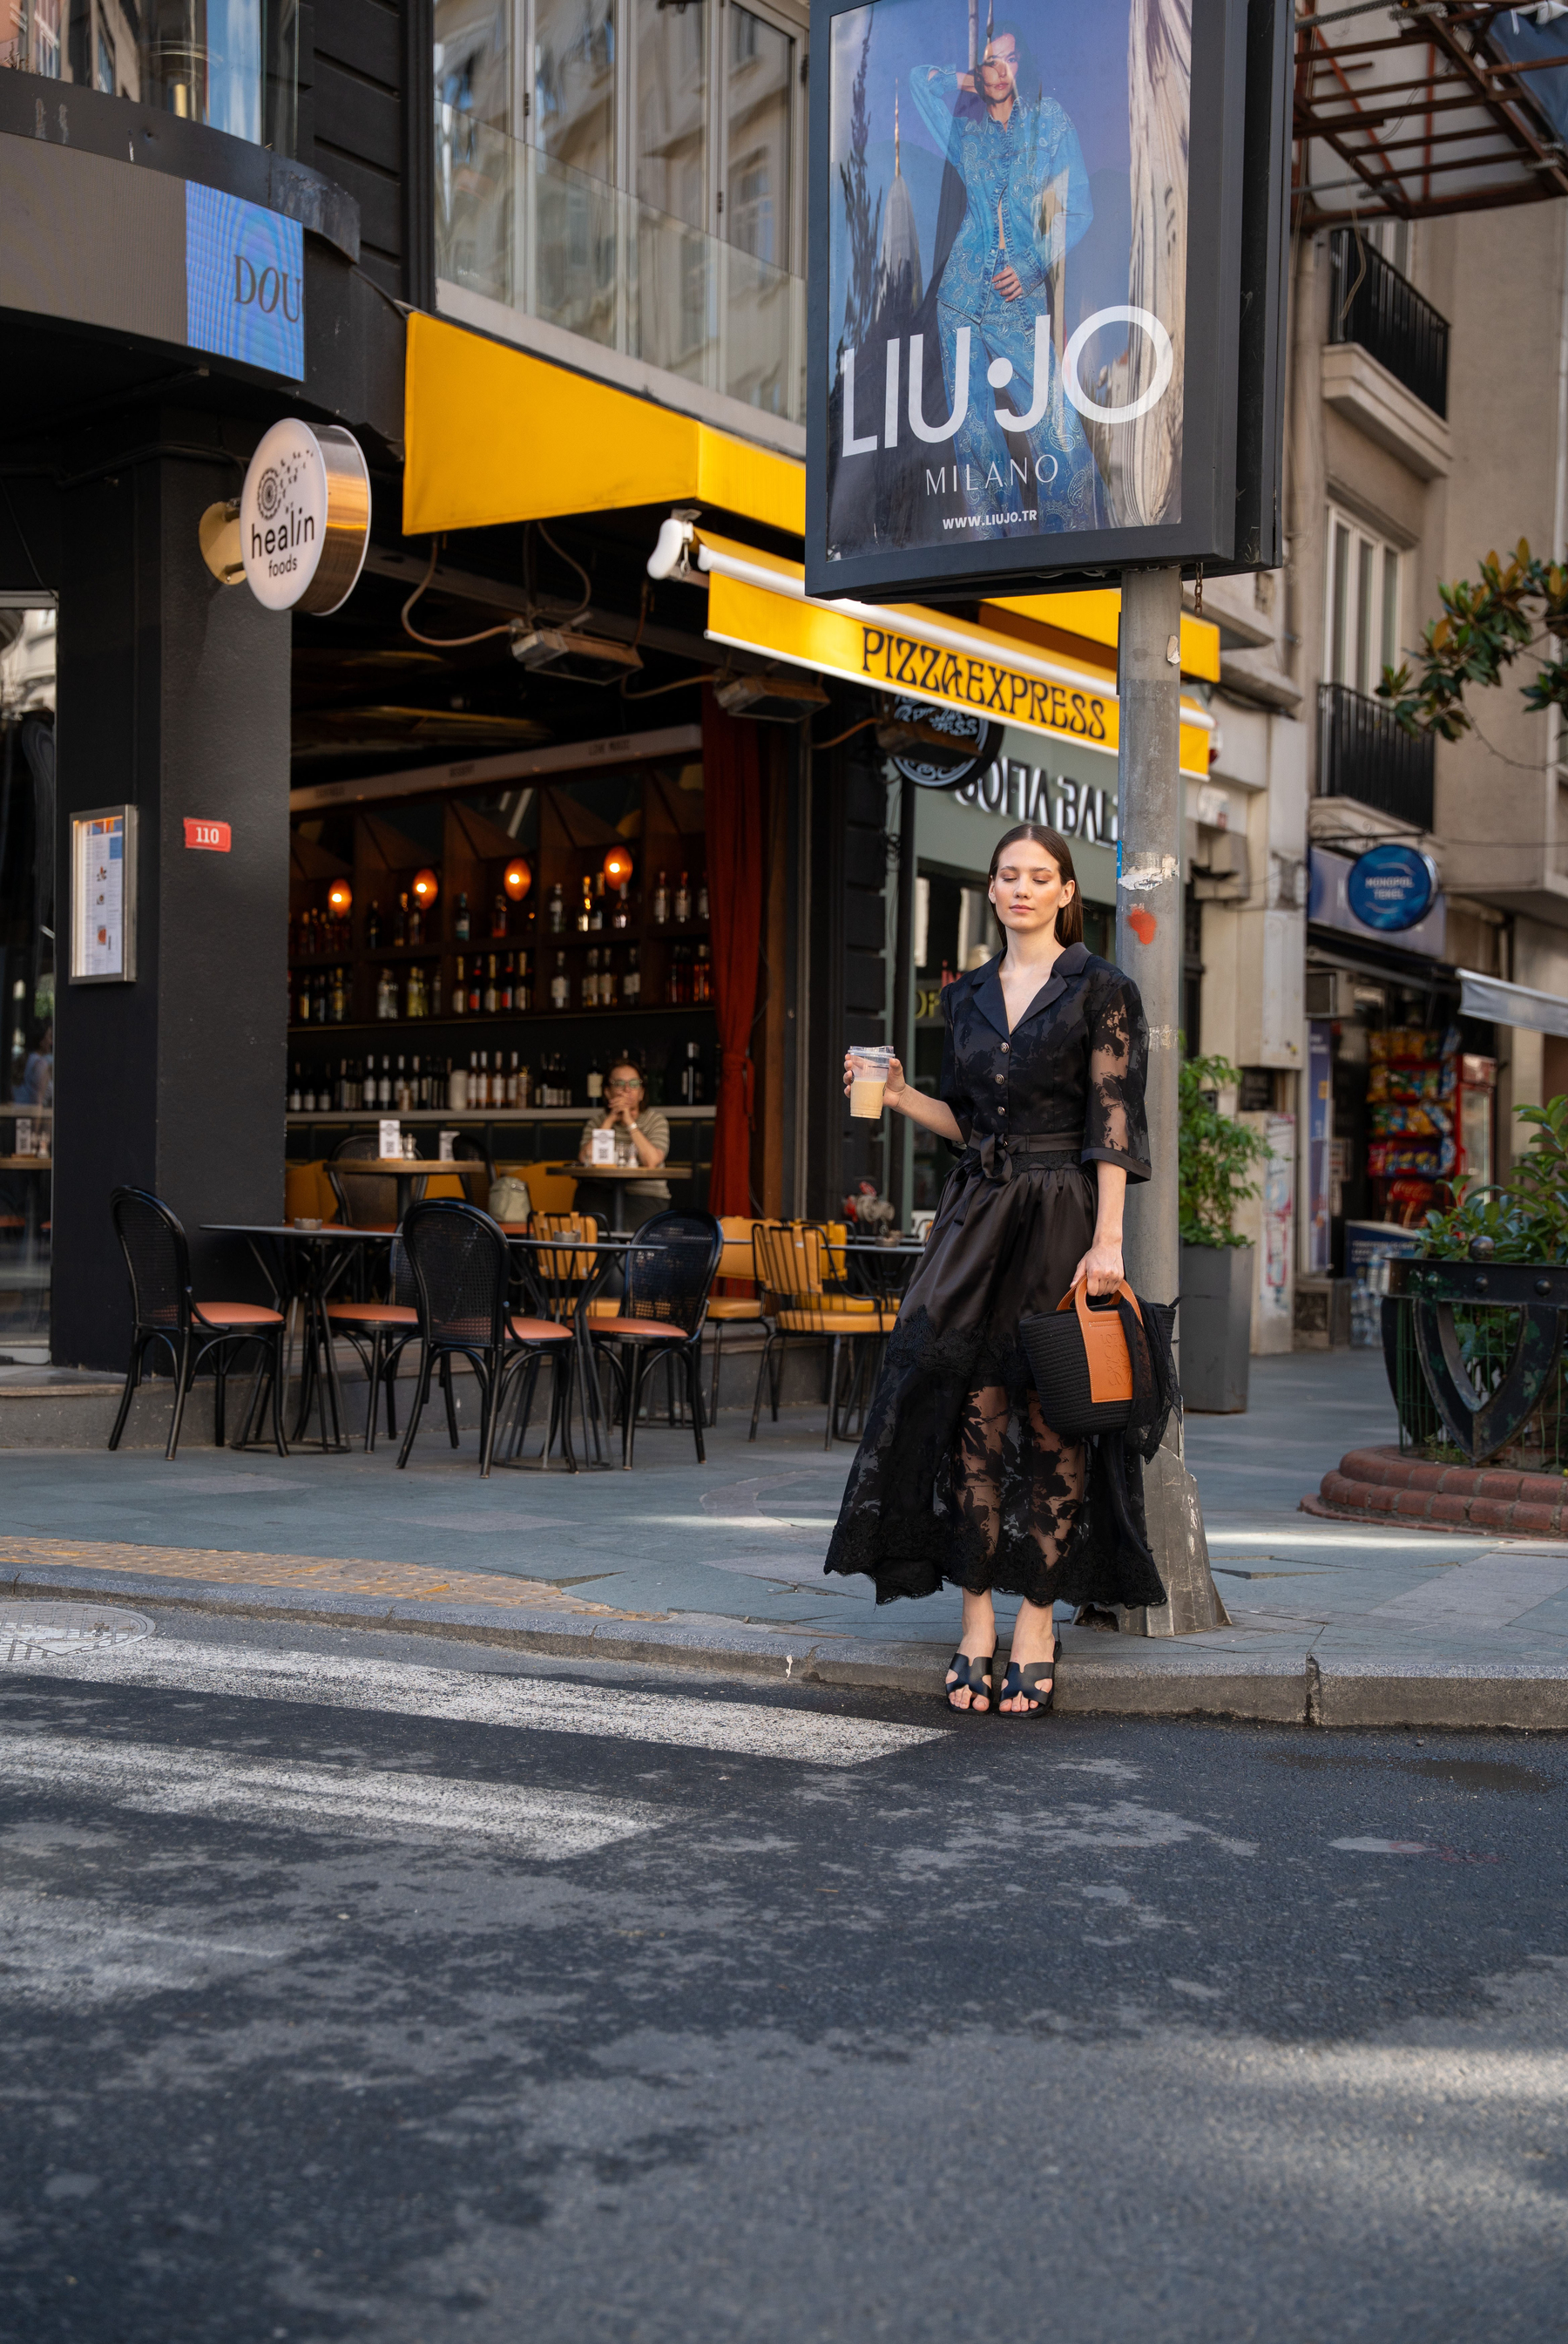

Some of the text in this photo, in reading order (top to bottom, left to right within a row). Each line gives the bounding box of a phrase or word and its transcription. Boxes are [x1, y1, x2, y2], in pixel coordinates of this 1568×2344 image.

[233, 254, 301, 323] DOU
[925, 454, 1059, 496] MILANO
[252, 507, 314, 559] healin
[943, 509, 1037, 531] WWW.LIUJO.TR
[268, 554, 298, 578] foods
[196, 826, 220, 845] 110
